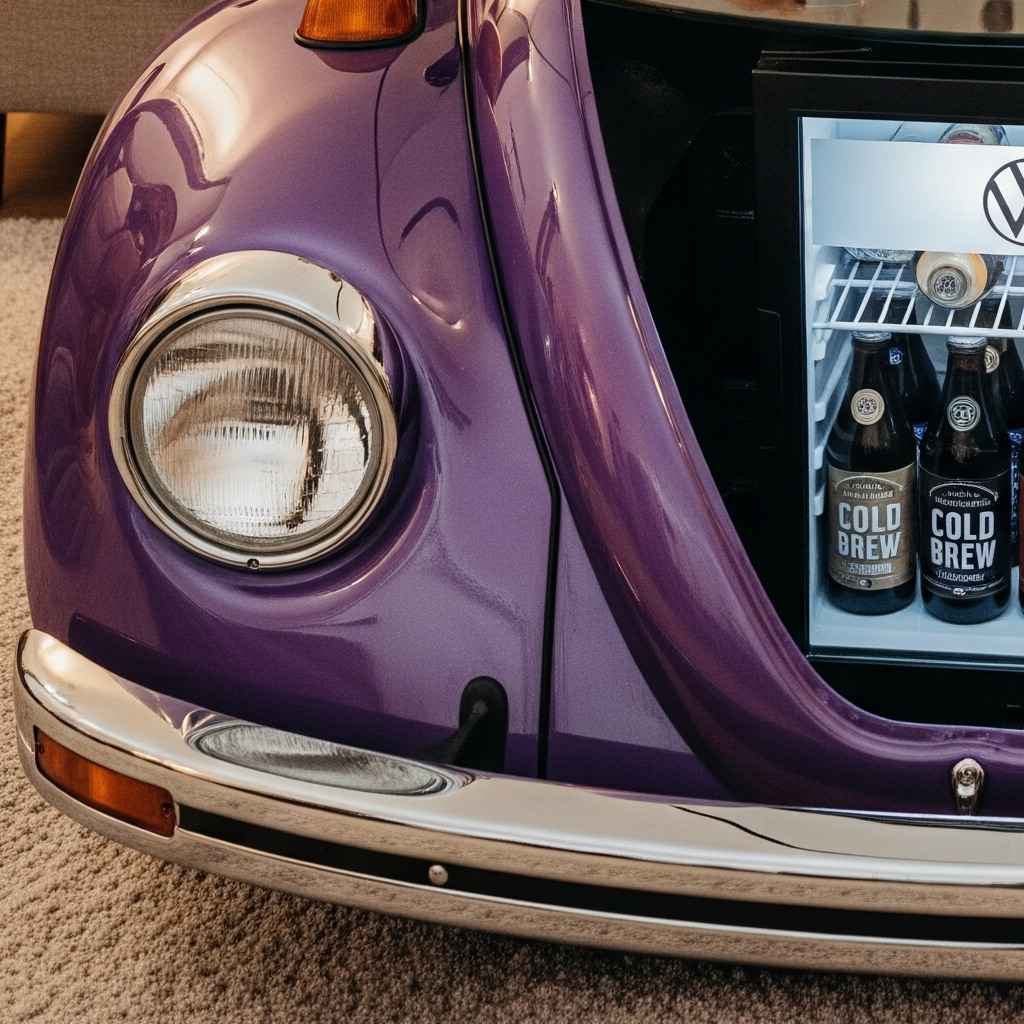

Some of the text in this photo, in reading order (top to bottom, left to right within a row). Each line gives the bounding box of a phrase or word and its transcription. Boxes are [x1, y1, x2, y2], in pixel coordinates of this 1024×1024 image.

[838, 502, 902, 533] COLD
[931, 507, 995, 541] COLD
[837, 530, 903, 560] BREW
[930, 536, 997, 570] BREW
